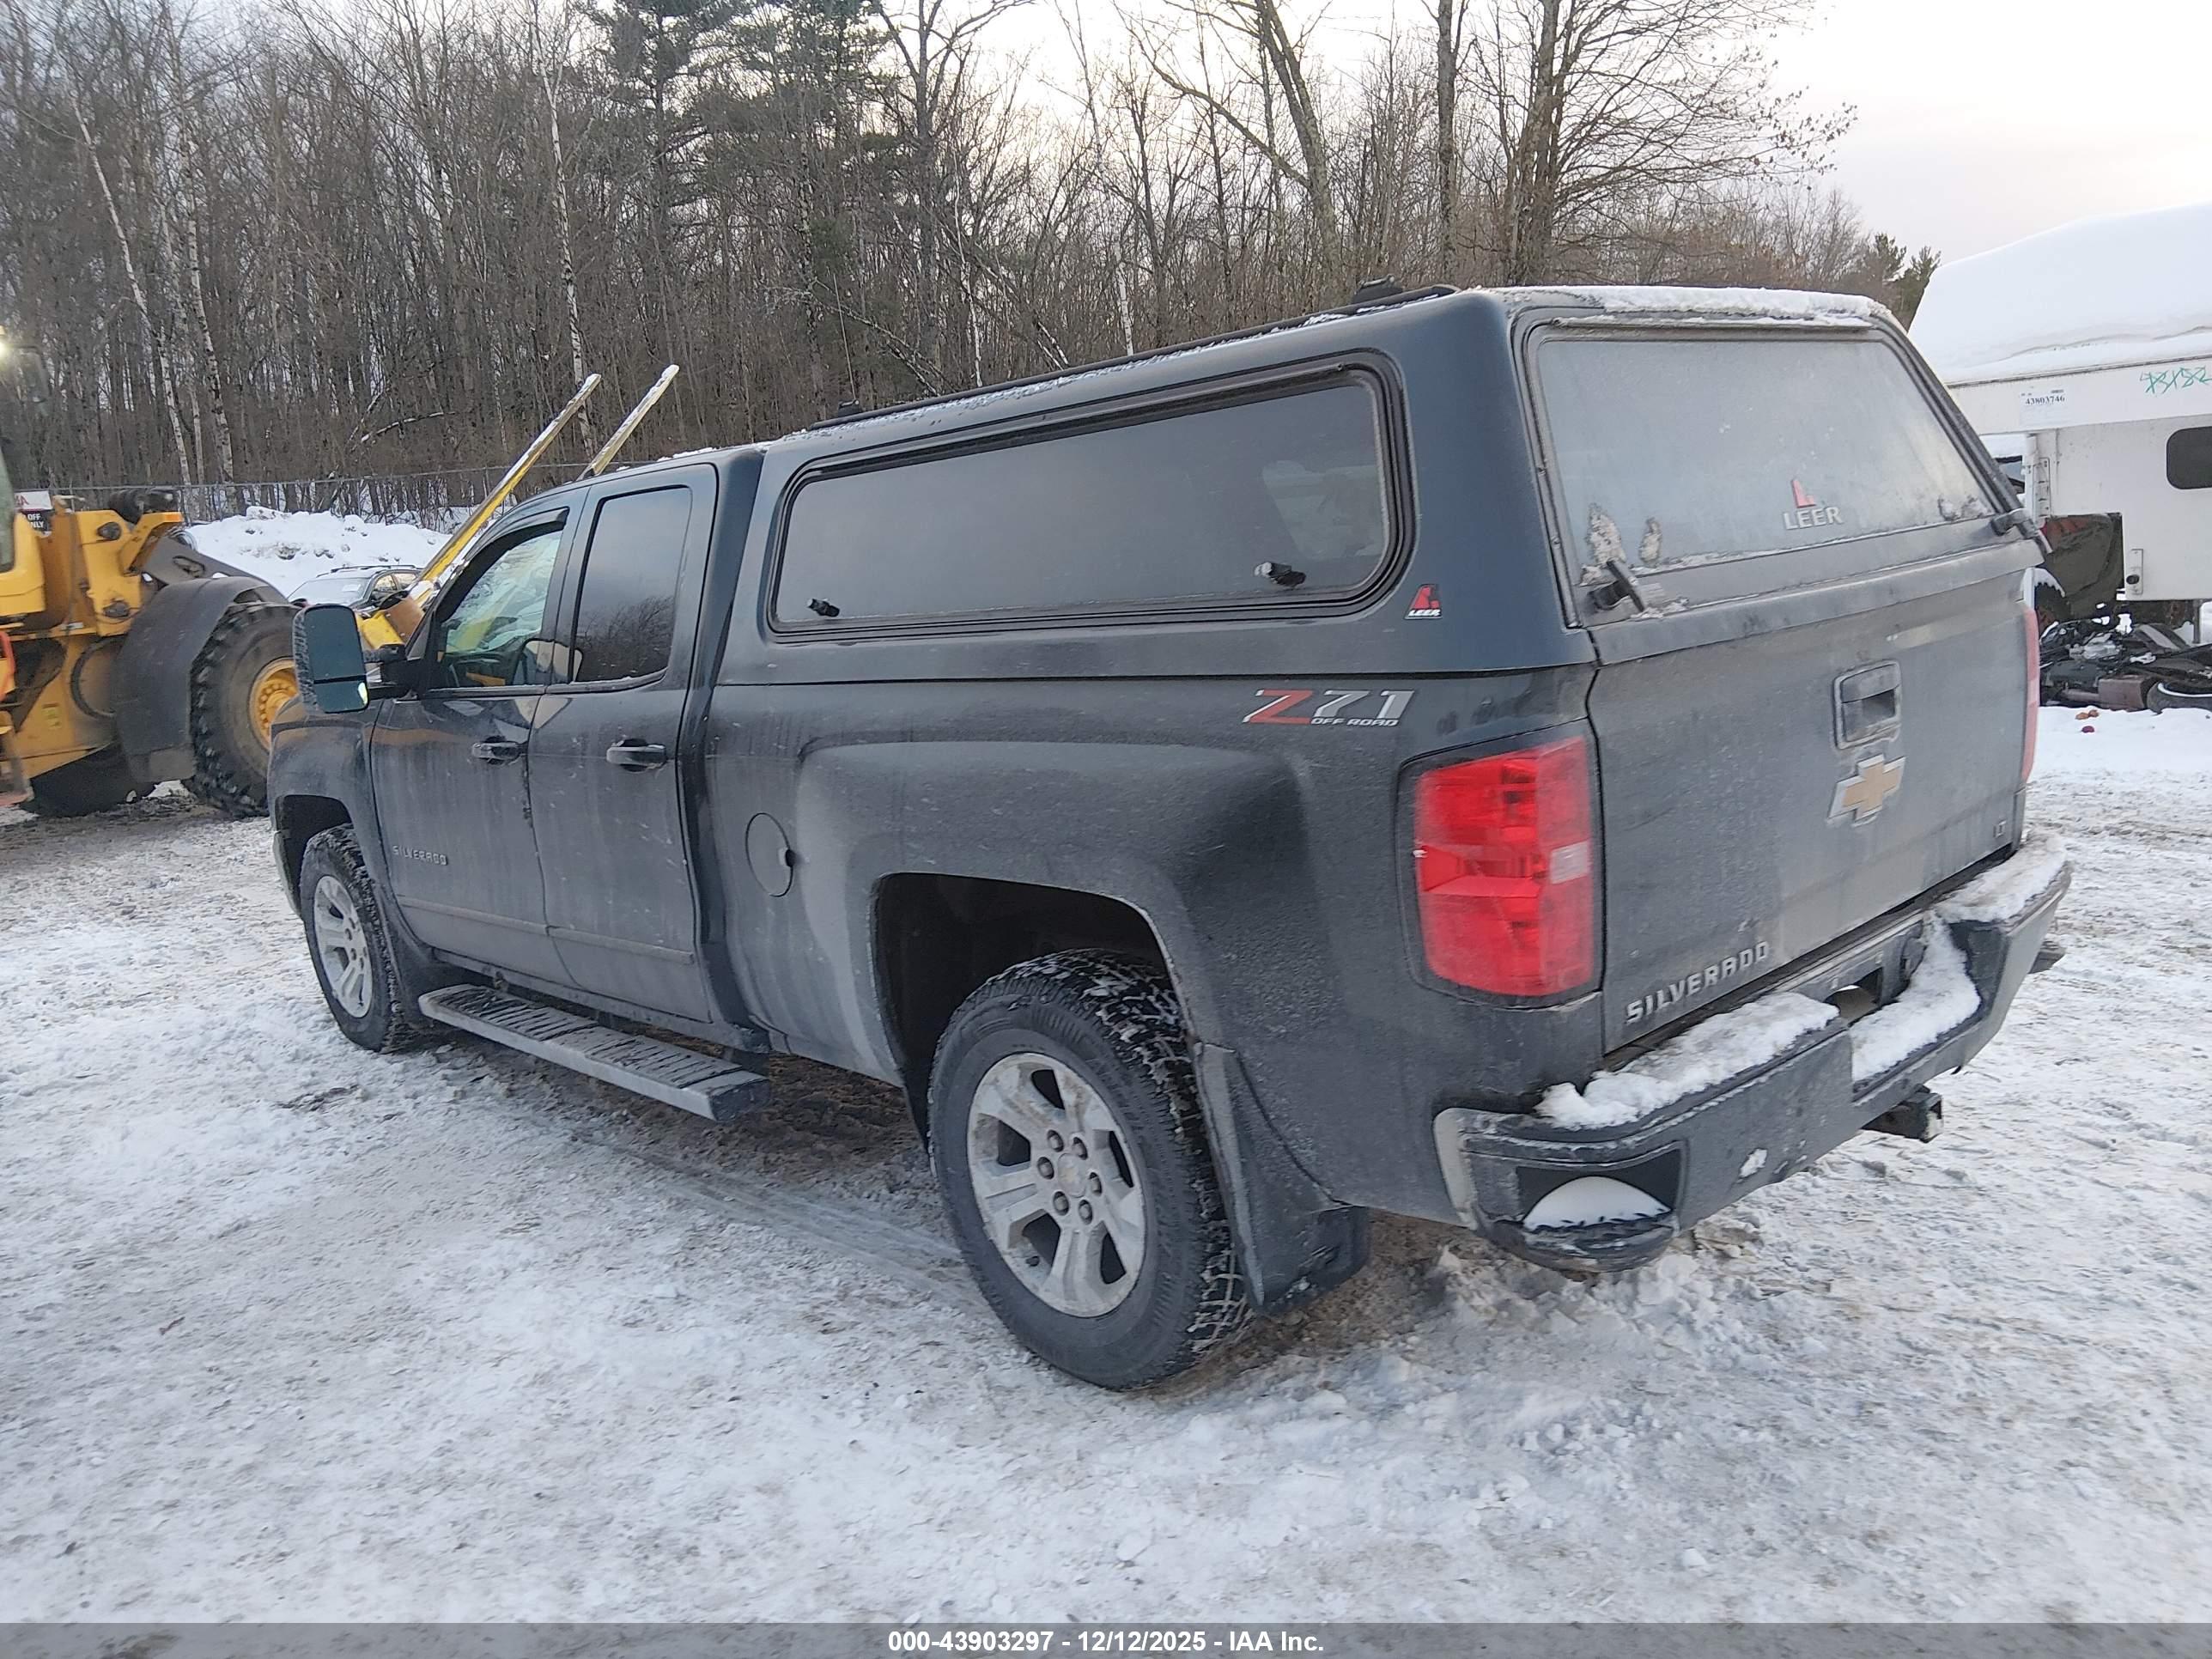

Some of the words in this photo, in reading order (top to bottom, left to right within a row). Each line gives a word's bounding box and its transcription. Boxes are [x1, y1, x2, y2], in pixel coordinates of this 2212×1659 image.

[1783, 507, 1844, 530] LEER
[1243, 690, 1415, 724] Z71
[392, 845, 448, 866] SILVERADO
[1626, 940, 1770, 1025] SILVERADO
